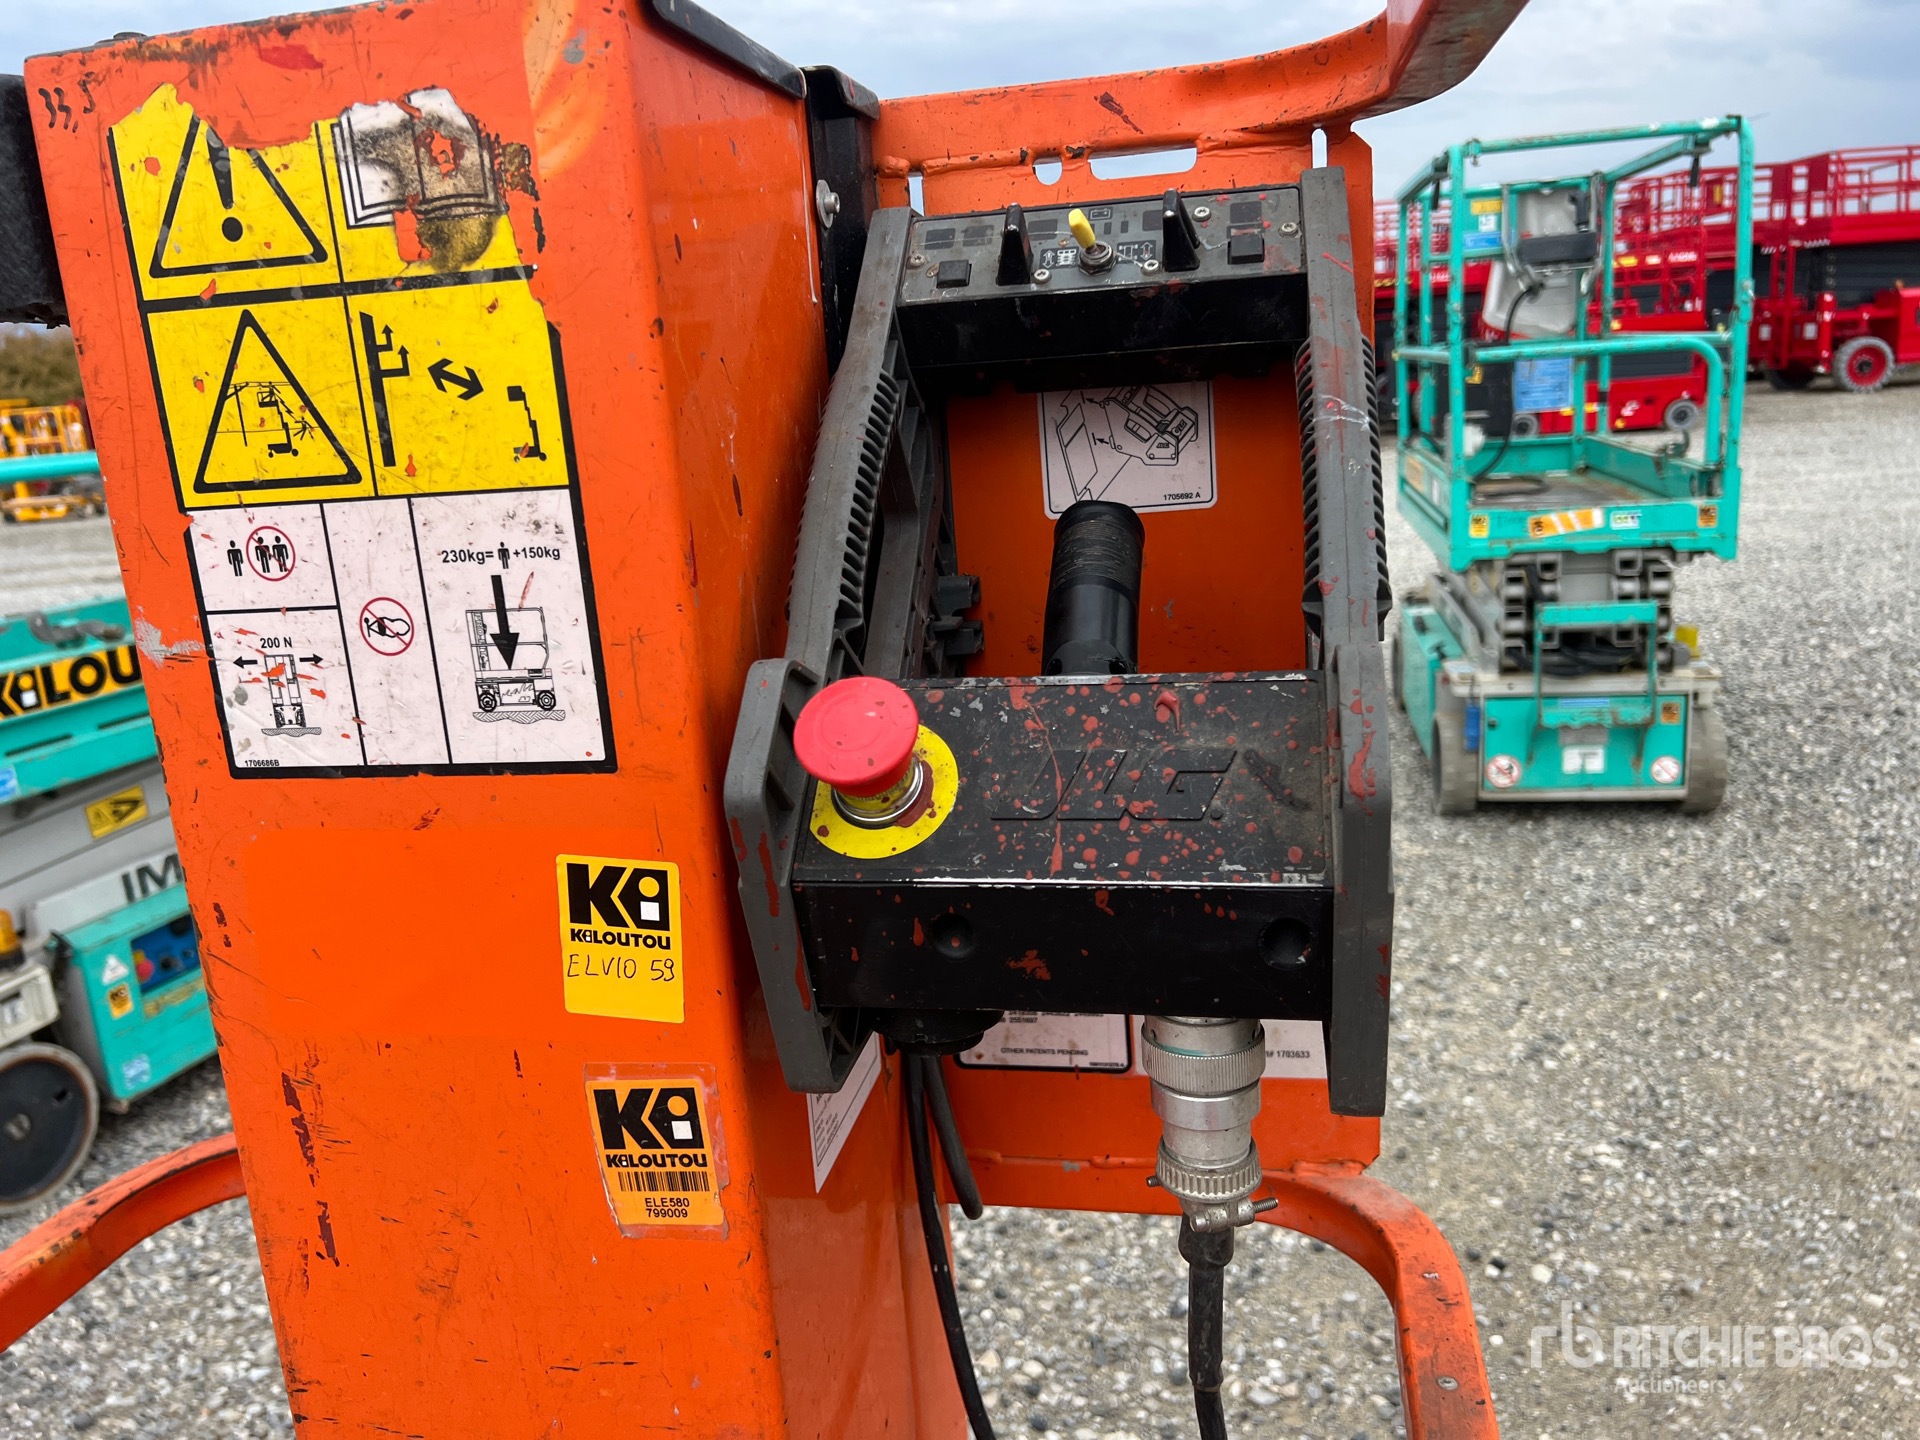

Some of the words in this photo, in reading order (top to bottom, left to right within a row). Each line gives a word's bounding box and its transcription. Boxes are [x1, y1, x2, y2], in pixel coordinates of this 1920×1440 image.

[1164, 493, 1194, 501] 1705692
[442, 549, 494, 565] 230kg=
[513, 546, 560, 560] +150kg
[260, 637, 280, 649] 200
[284, 636, 293, 648] N
[991, 750, 1237, 821] JLG
[650, 958, 675, 982] 59
[1025, 1047, 1056, 1055] PATENTS
[1276, 1050, 1310, 1059] 1703633
[645, 1197, 690, 1208] ELE580
[645, 1208, 688, 1218] 799009
